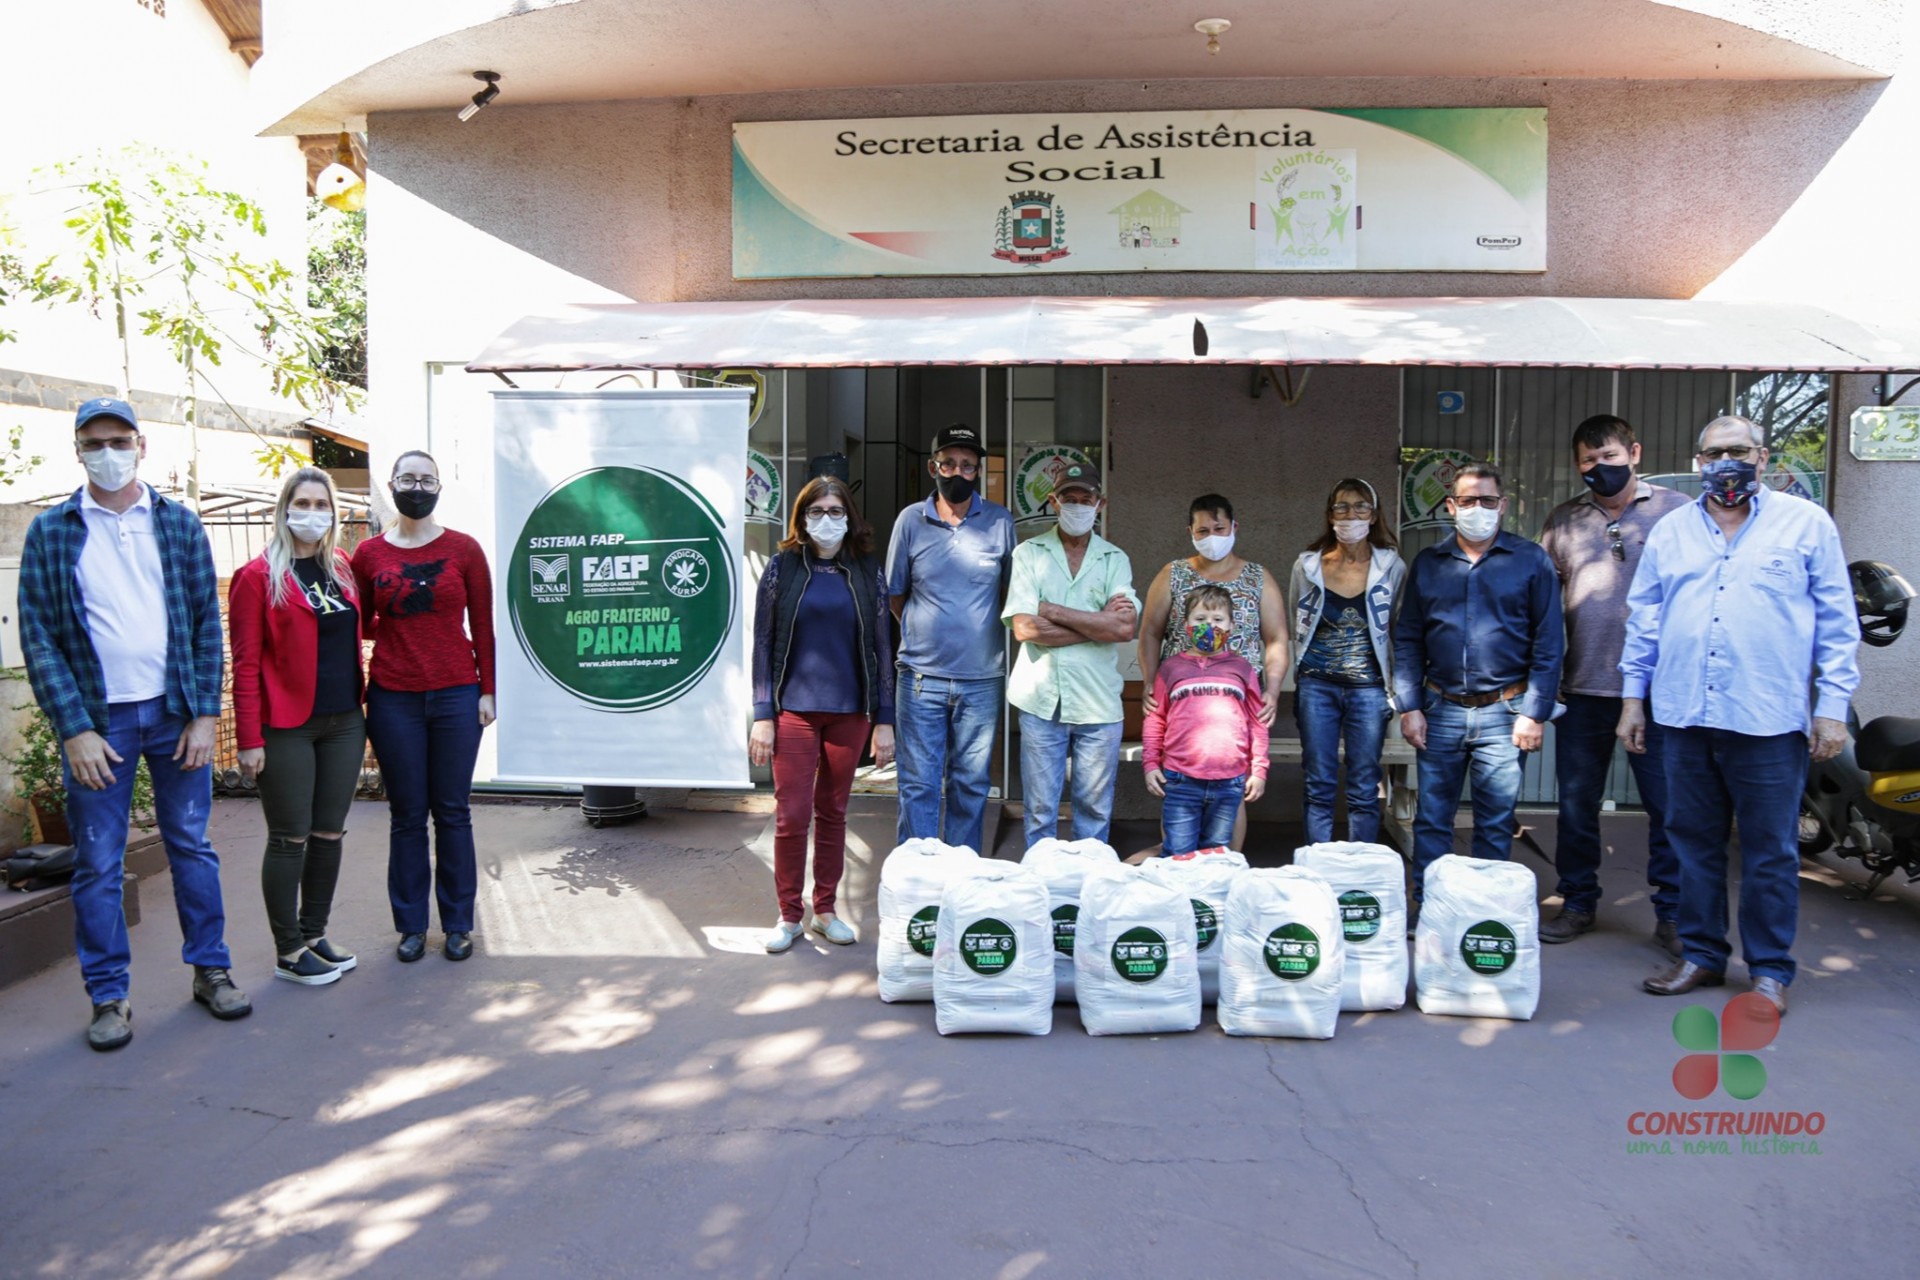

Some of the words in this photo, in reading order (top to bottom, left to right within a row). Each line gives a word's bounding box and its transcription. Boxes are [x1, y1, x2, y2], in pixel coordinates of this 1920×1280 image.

[835, 129, 1024, 156] Secretaria
[1037, 124, 1083, 151] de
[1095, 122, 1316, 149] Assistência
[1005, 156, 1165, 183] Social
[1260, 150, 1352, 183] Voluntários
[1298, 188, 1326, 200] em
[1281, 243, 1330, 259] Ação
[529, 535, 587, 549] SISTEMA
[589, 533, 625, 546] FAEP
[666, 550, 705, 567] SINDICATO
[582, 554, 650, 581] FAEP
[533, 583, 568, 594] SENAR
[671, 585, 703, 595] RURAL
[565, 609, 600, 625] AGRO
[602, 607, 671, 624] FRATERNO
[577, 617, 682, 656] PARANÁ
[578, 657, 680, 668] www.sistemafaep.org.br
[1192, 686, 1220, 697] GAMES
